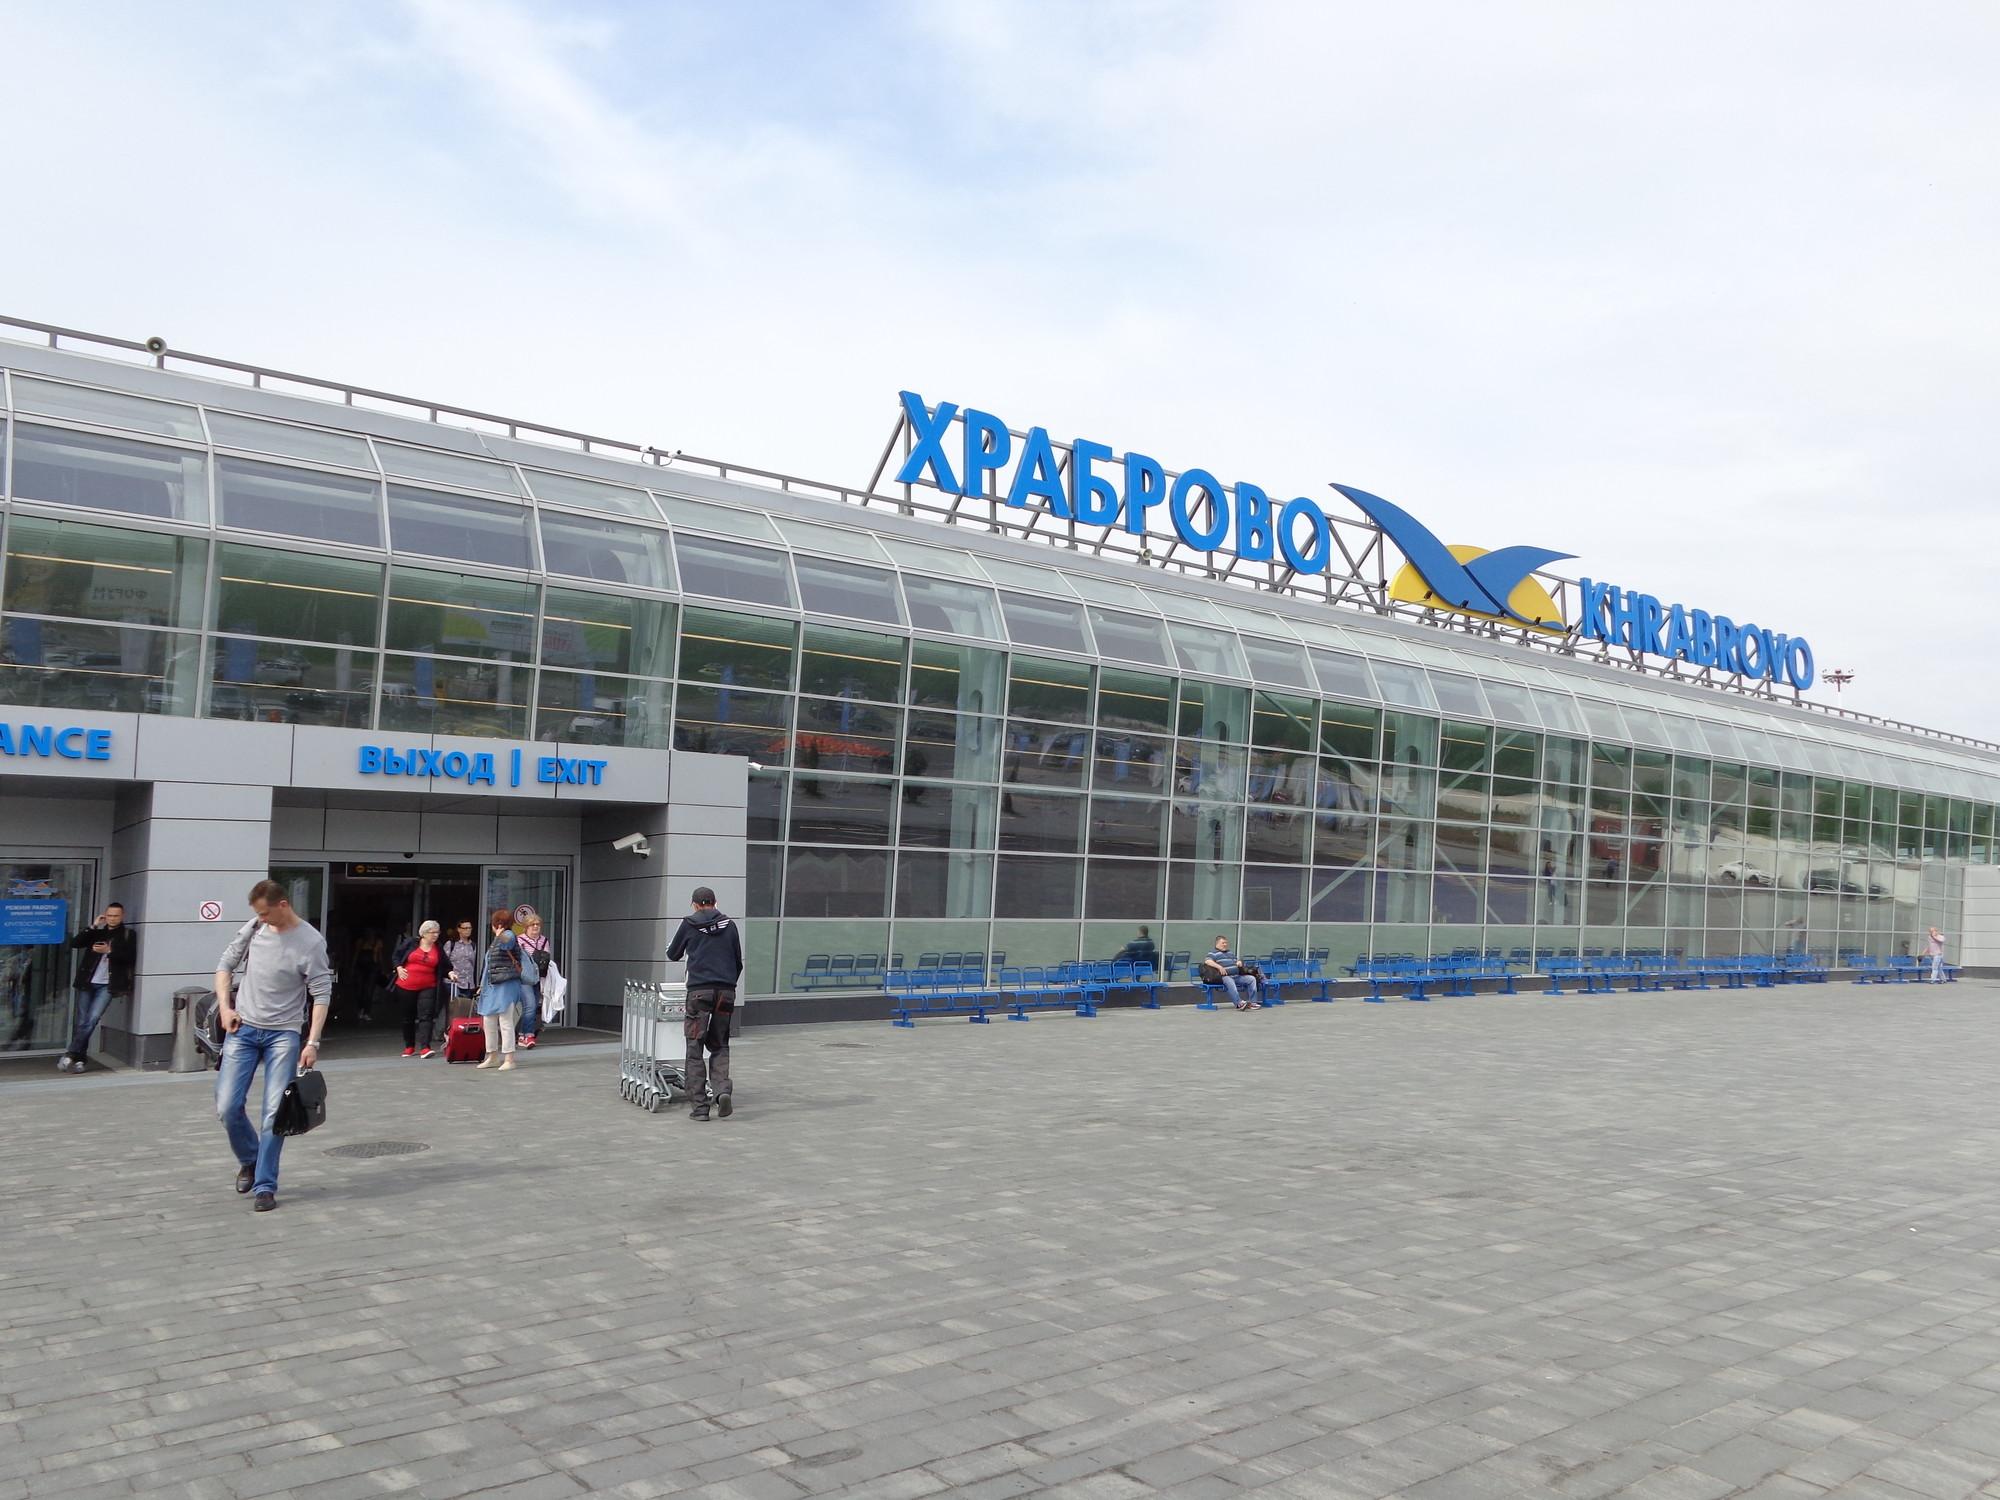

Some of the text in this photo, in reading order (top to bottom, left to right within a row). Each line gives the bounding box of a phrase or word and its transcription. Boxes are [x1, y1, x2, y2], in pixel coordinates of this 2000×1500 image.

[895, 390, 1329, 575] ХРАБРОВО
[1579, 577, 1814, 690] KHRABROVO
[358, 745, 496, 785] ВЫХОД
[538, 756, 608, 785] EXIT
